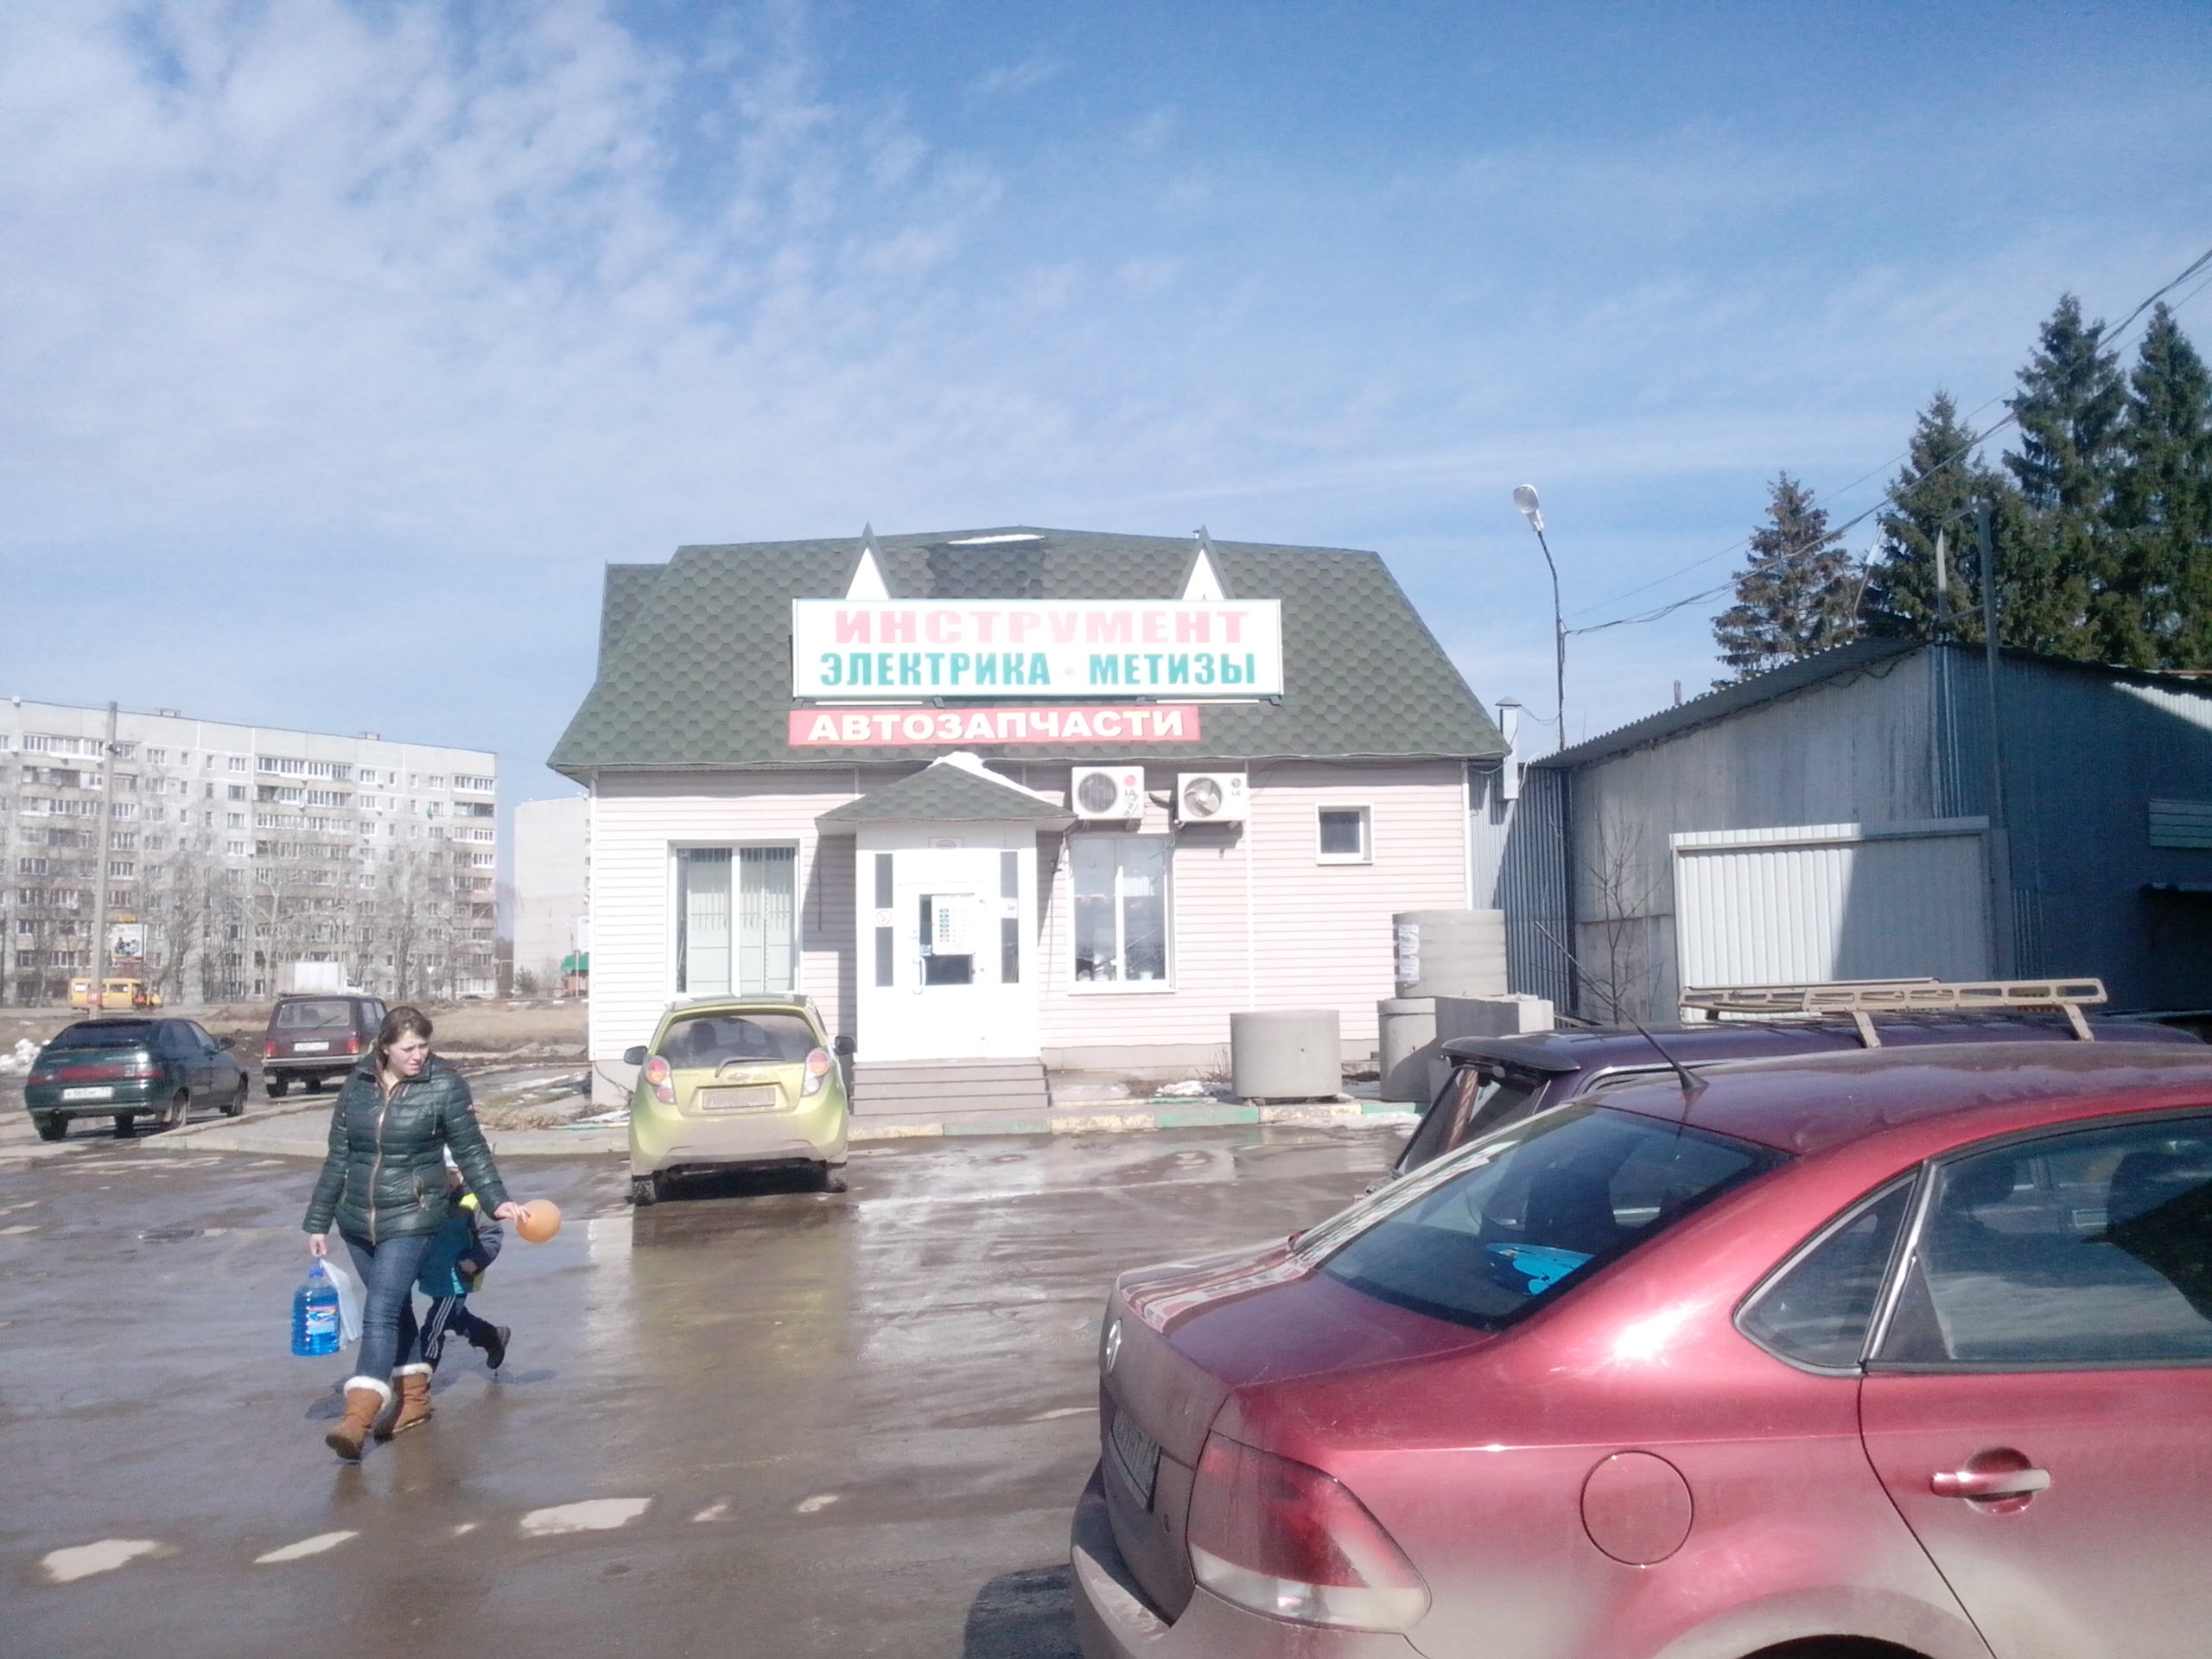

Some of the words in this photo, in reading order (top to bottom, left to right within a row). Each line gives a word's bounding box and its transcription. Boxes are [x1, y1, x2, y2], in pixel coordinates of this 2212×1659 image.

[836, 610, 1249, 644] ИНСТРУМЕНТ
[819, 652, 1052, 687] ЭЛЕКТРИКА
[1089, 652, 1256, 686] МЕТИЗЫ
[807, 710, 1184, 741] АВТОЗАПЧАСТИ
